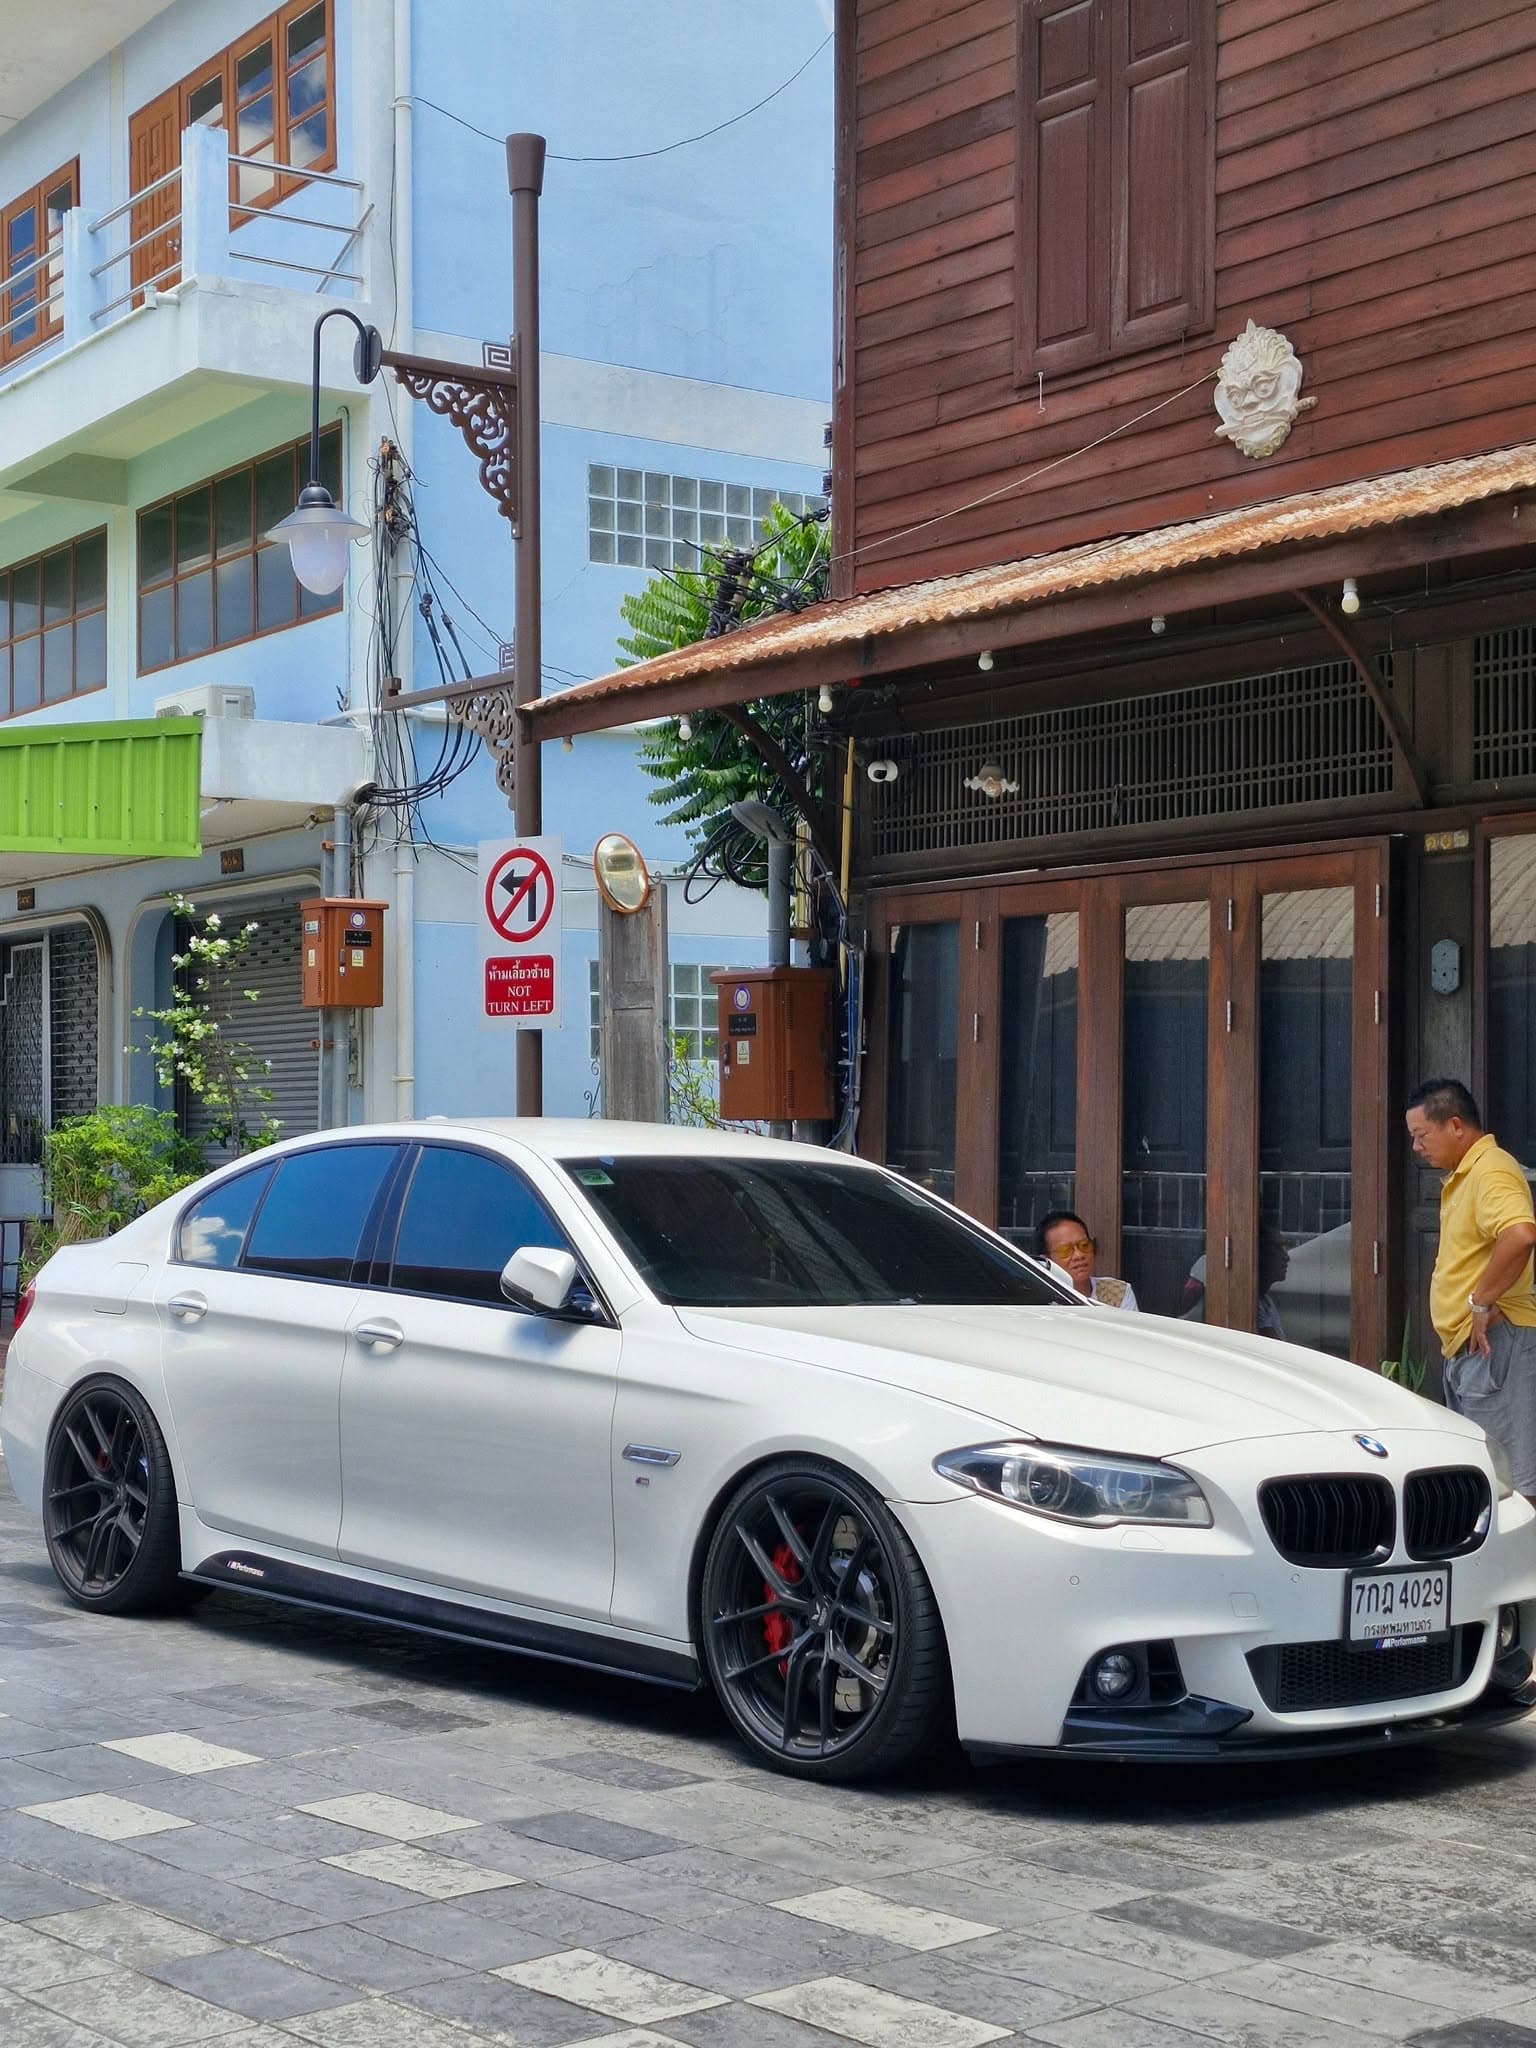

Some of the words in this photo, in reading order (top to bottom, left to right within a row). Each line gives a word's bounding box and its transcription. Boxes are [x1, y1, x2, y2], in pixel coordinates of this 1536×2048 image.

[488, 960, 550, 980] ห้ามเลี้ยวซ้าย
[507, 985, 531, 997] NOT
[487, 1001, 519, 1013] TURN
[523, 999, 551, 1012] LEFT
[1399, 1577, 1443, 1609] 4029
